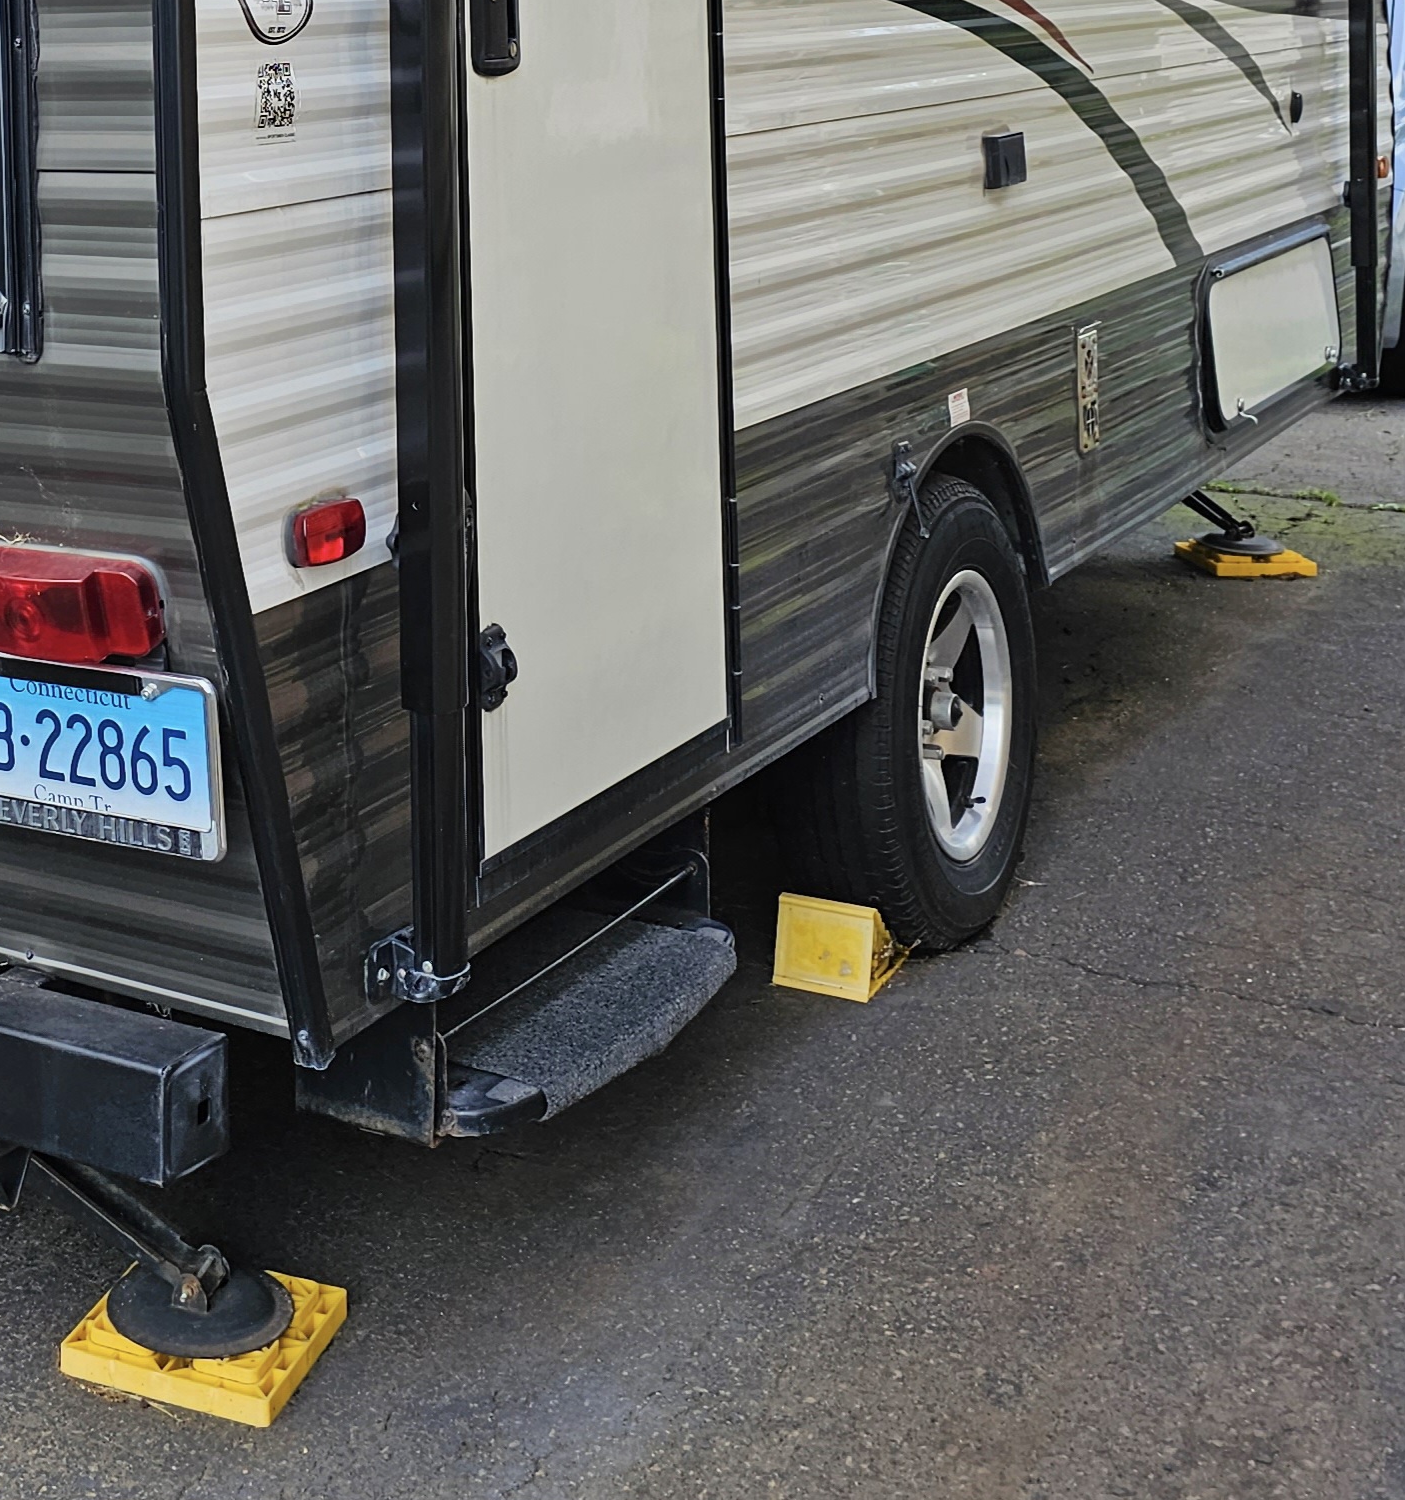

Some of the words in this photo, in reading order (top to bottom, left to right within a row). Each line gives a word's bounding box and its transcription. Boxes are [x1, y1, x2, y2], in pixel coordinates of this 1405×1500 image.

[9, 677, 132, 710] Connecticut
[33, 783, 84, 808] Camp
[99, 809, 173, 851] HILLS
